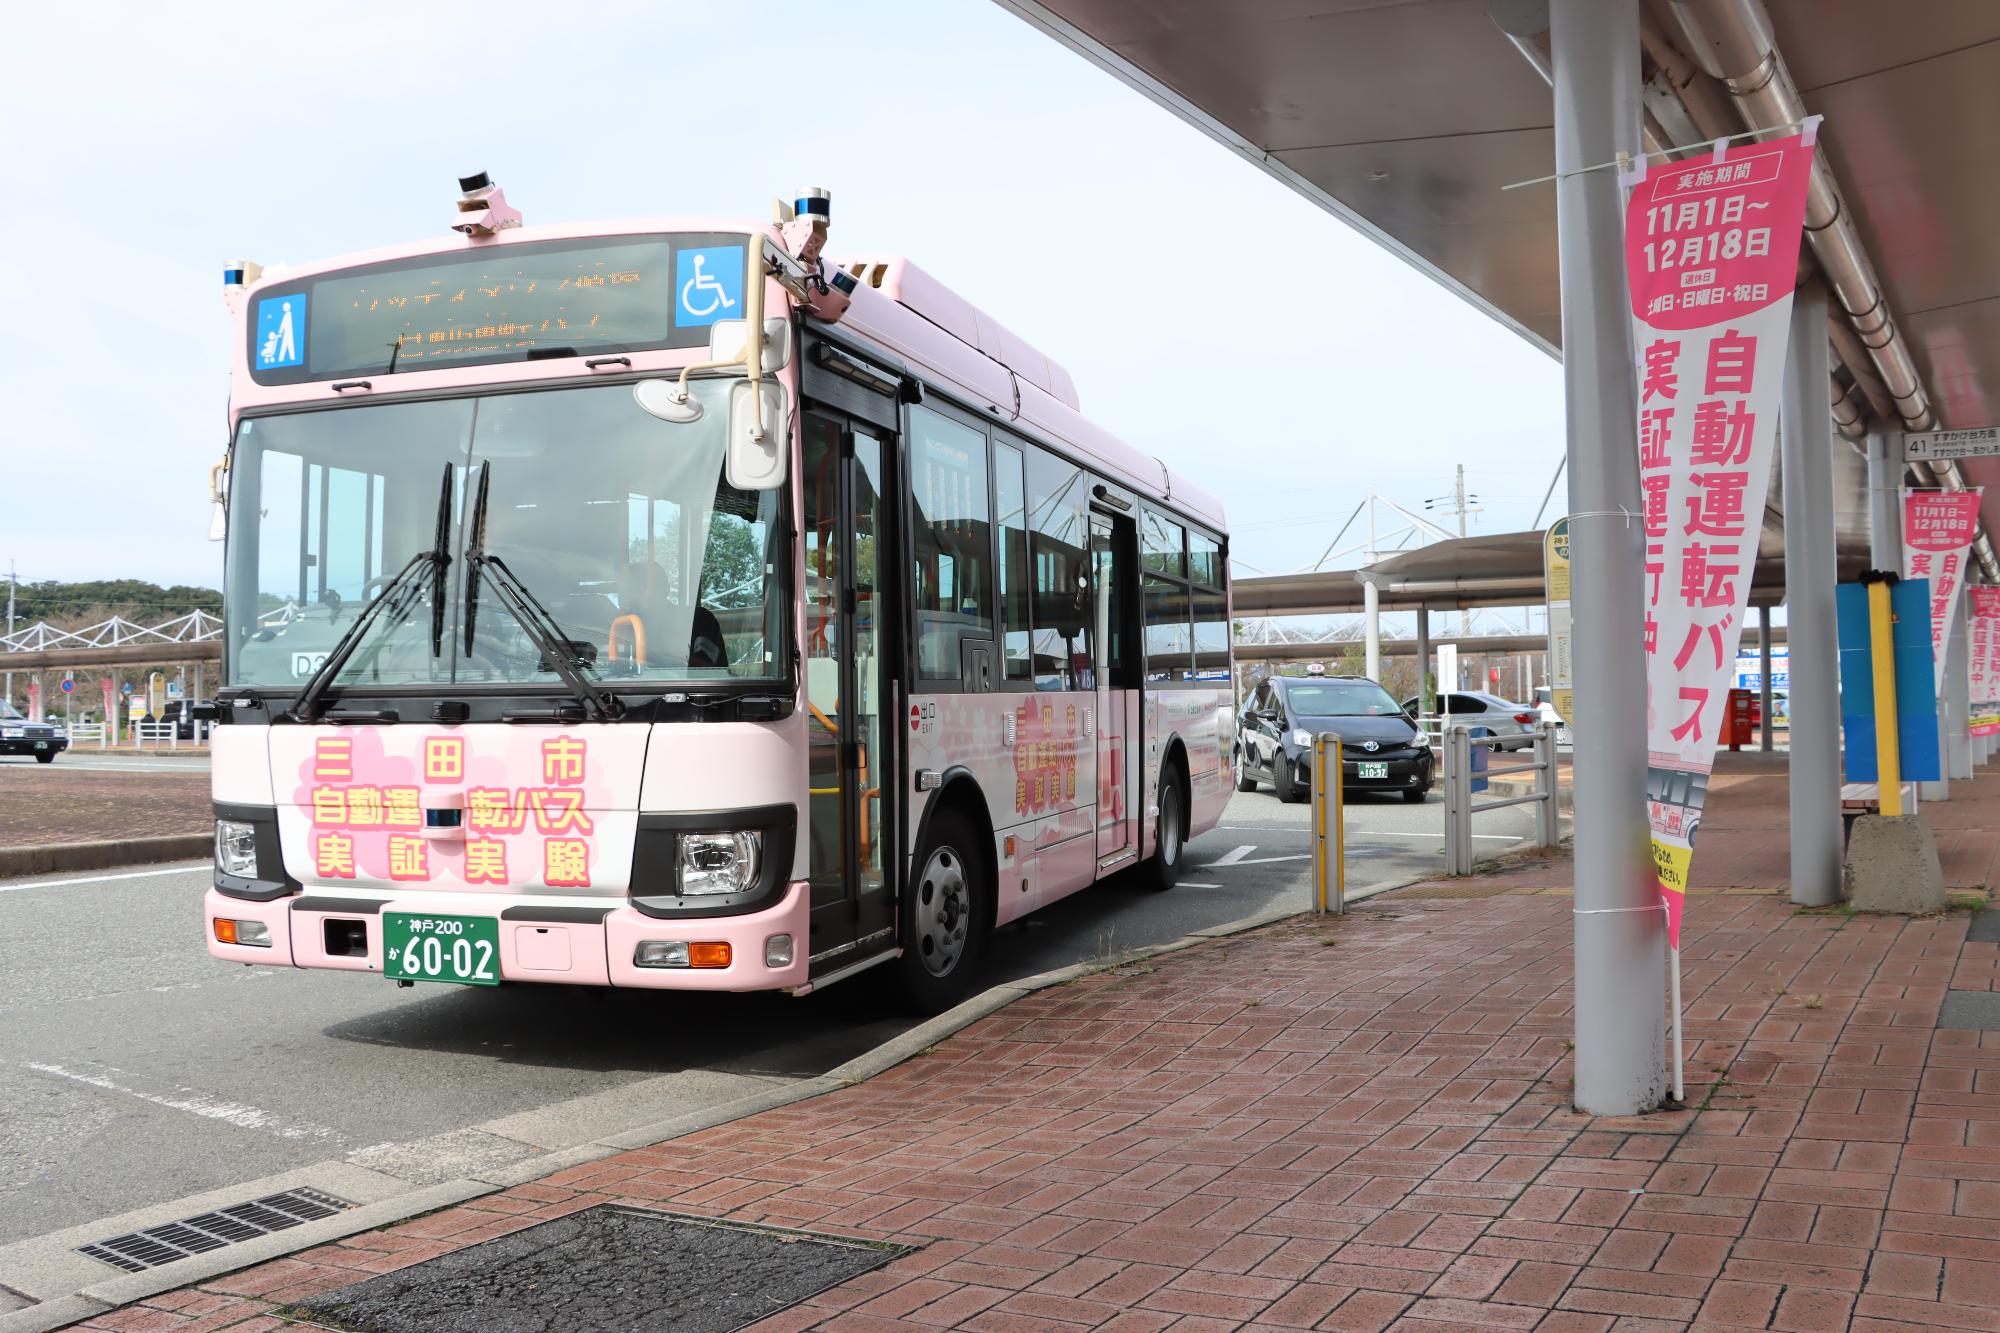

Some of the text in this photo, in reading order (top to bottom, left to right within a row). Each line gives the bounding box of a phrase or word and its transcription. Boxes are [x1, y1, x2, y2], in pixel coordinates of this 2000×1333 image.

[1677, 163, 1752, 190] 実施期間
[1643, 228, 1771, 272] 12月18日
[1909, 440, 1926, 453] 41
[1670, 329, 1757, 743] 自動運転バス
[1914, 519, 1968, 530] 12月18日
[921, 701, 935, 719] 出口
[1017, 704, 1075, 736] 三田市
[315, 737, 586, 783] 三田市
[1017, 739, 1076, 772] 自動運転バス
[312, 786, 592, 830] 自動運転バス
[1016, 769, 1075, 808] 実証実験
[317, 835, 588, 882] 実証実験
[388, 936, 494, 979] か 60-02
